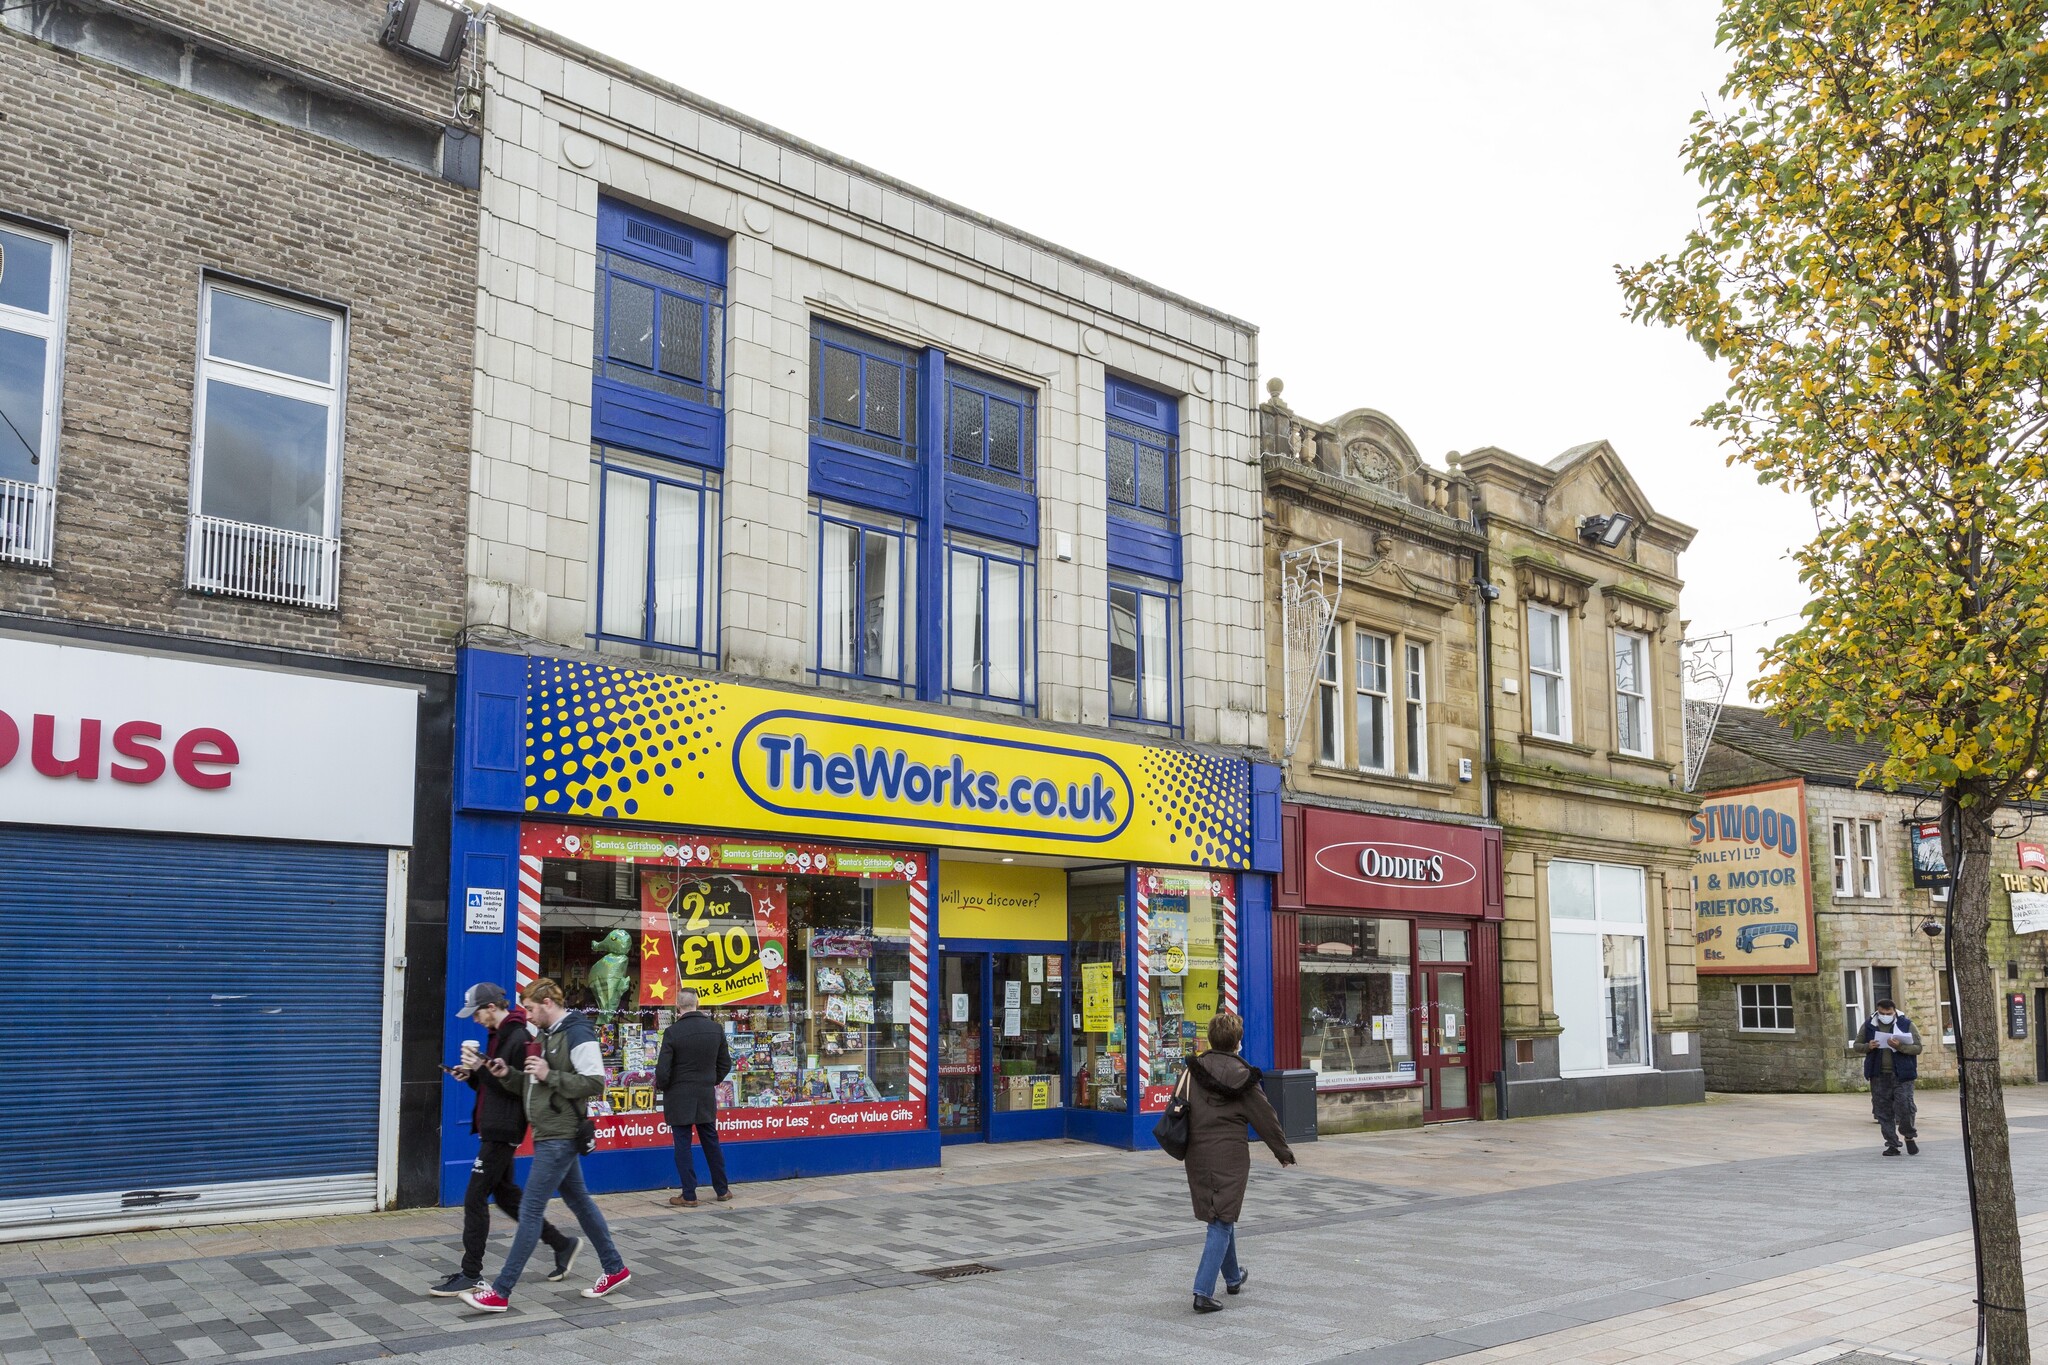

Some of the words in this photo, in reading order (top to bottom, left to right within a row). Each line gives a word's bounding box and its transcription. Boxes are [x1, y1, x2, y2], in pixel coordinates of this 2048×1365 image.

[757, 733, 1116, 825] TheWorks.co.uk
[1689, 804, 1797, 858] STWOOD
[595, 840, 625, 850] Santa's
[627, 841, 662, 852] Giftshop
[723, 849, 751, 858] Santa's
[752, 850, 784, 860] Giftshop
[838, 858, 862, 867] Santa's
[863, 859, 893, 868] Giftshop
[1360, 848, 1444, 882] ODDIE'S
[1708, 873, 1721, 891] &
[1728, 867, 1796, 890] MOTOR
[2000, 873, 2029, 892] THE
[941, 889, 960, 904] will
[963, 896, 984, 910] you
[986, 891, 1041, 908] discover?
[682, 891, 710, 931] 2
[708, 901, 731, 917] for
[680, 926, 751, 975] £10
[1168, 952, 1184, 964] 75%
[1704, 949, 1725, 960] Etc.
[713, 983, 722, 994] &
[725, 971, 764, 991] Match!
[1196, 1003, 1211, 1011] Gifts
[1098, 1067, 1111, 1075] 2021
[767, 1117, 784, 1128] For
[786, 1115, 809, 1127] Less
[829, 1112, 859, 1125] Great
[861, 1111, 888, 1122] Value
[890, 1110, 913, 1121] Gifts
[618, 1122, 654, 1137] Value
